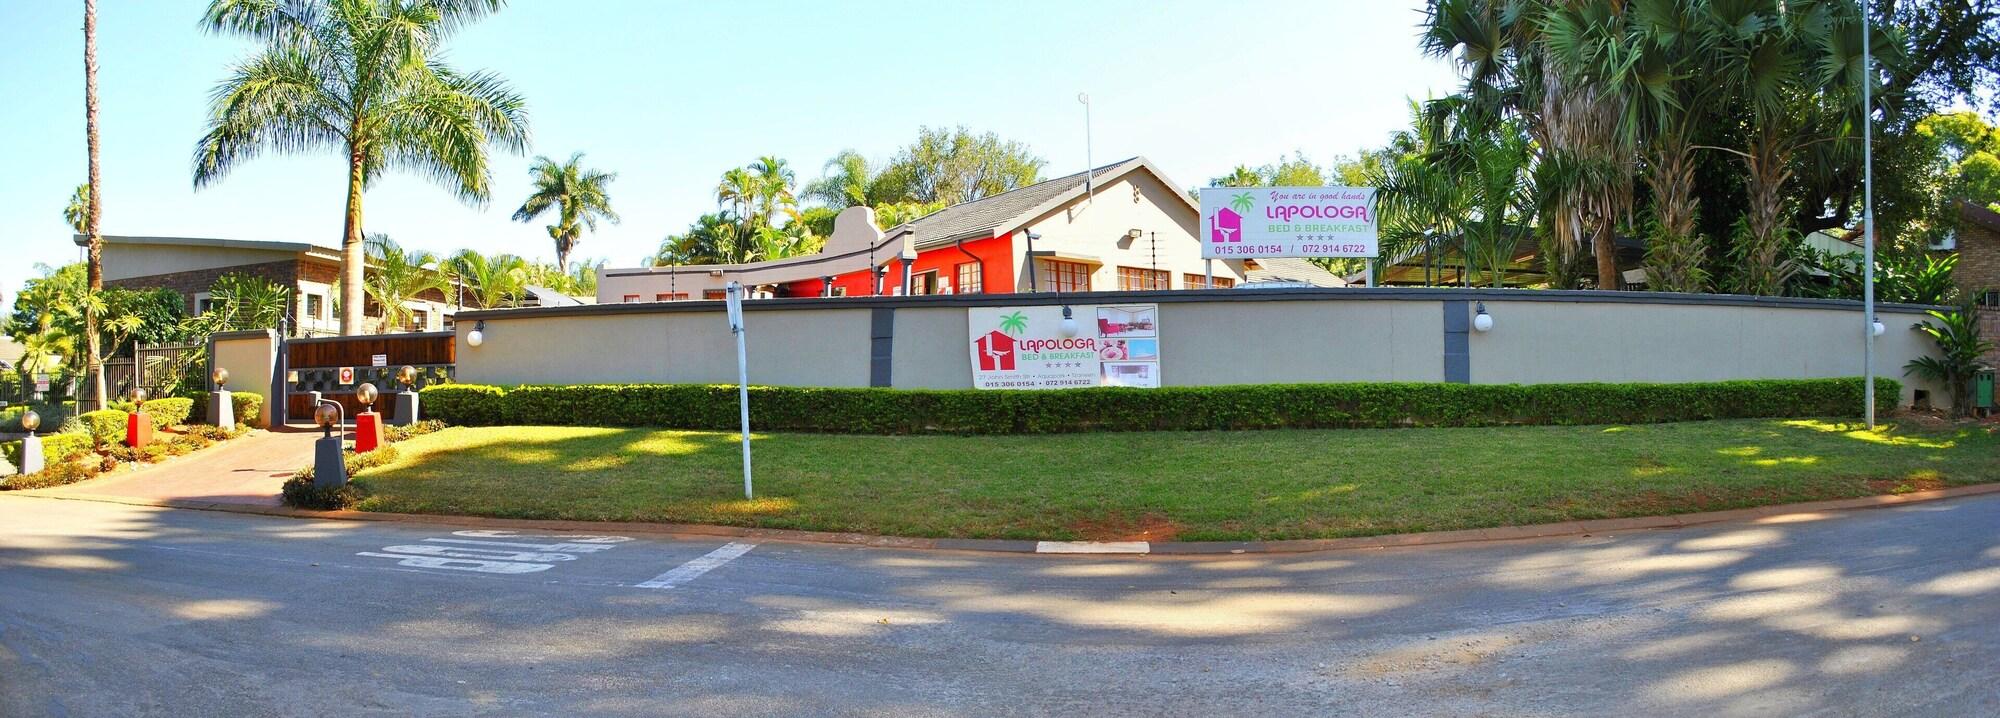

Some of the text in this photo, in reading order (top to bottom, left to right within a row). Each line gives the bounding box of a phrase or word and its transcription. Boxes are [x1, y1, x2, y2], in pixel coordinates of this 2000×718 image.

[1270, 190, 1289, 203] You
[1309, 191, 1318, 200] in
[1320, 191, 1339, 203] good
[1341, 191, 1366, 200] hands
[1266, 205, 1369, 223] LAPOLOGA
[1268, 224, 1369, 233] BED & BREAKFAST
[1215, 246, 1233, 254] 015
[1237, 245, 1255, 254] 306
[1258, 245, 1282, 254] 0154
[1302, 245, 1320, 253] 072
[1323, 245, 1340, 253] 914
[1342, 244, 1365, 253] 6722
[1020, 338, 1097, 353] LAPOLOGA
[1022, 353, 1039, 361] BED
[1049, 352, 1095, 360] BREAKFAST
[355, 530, 636, 574] STOP
